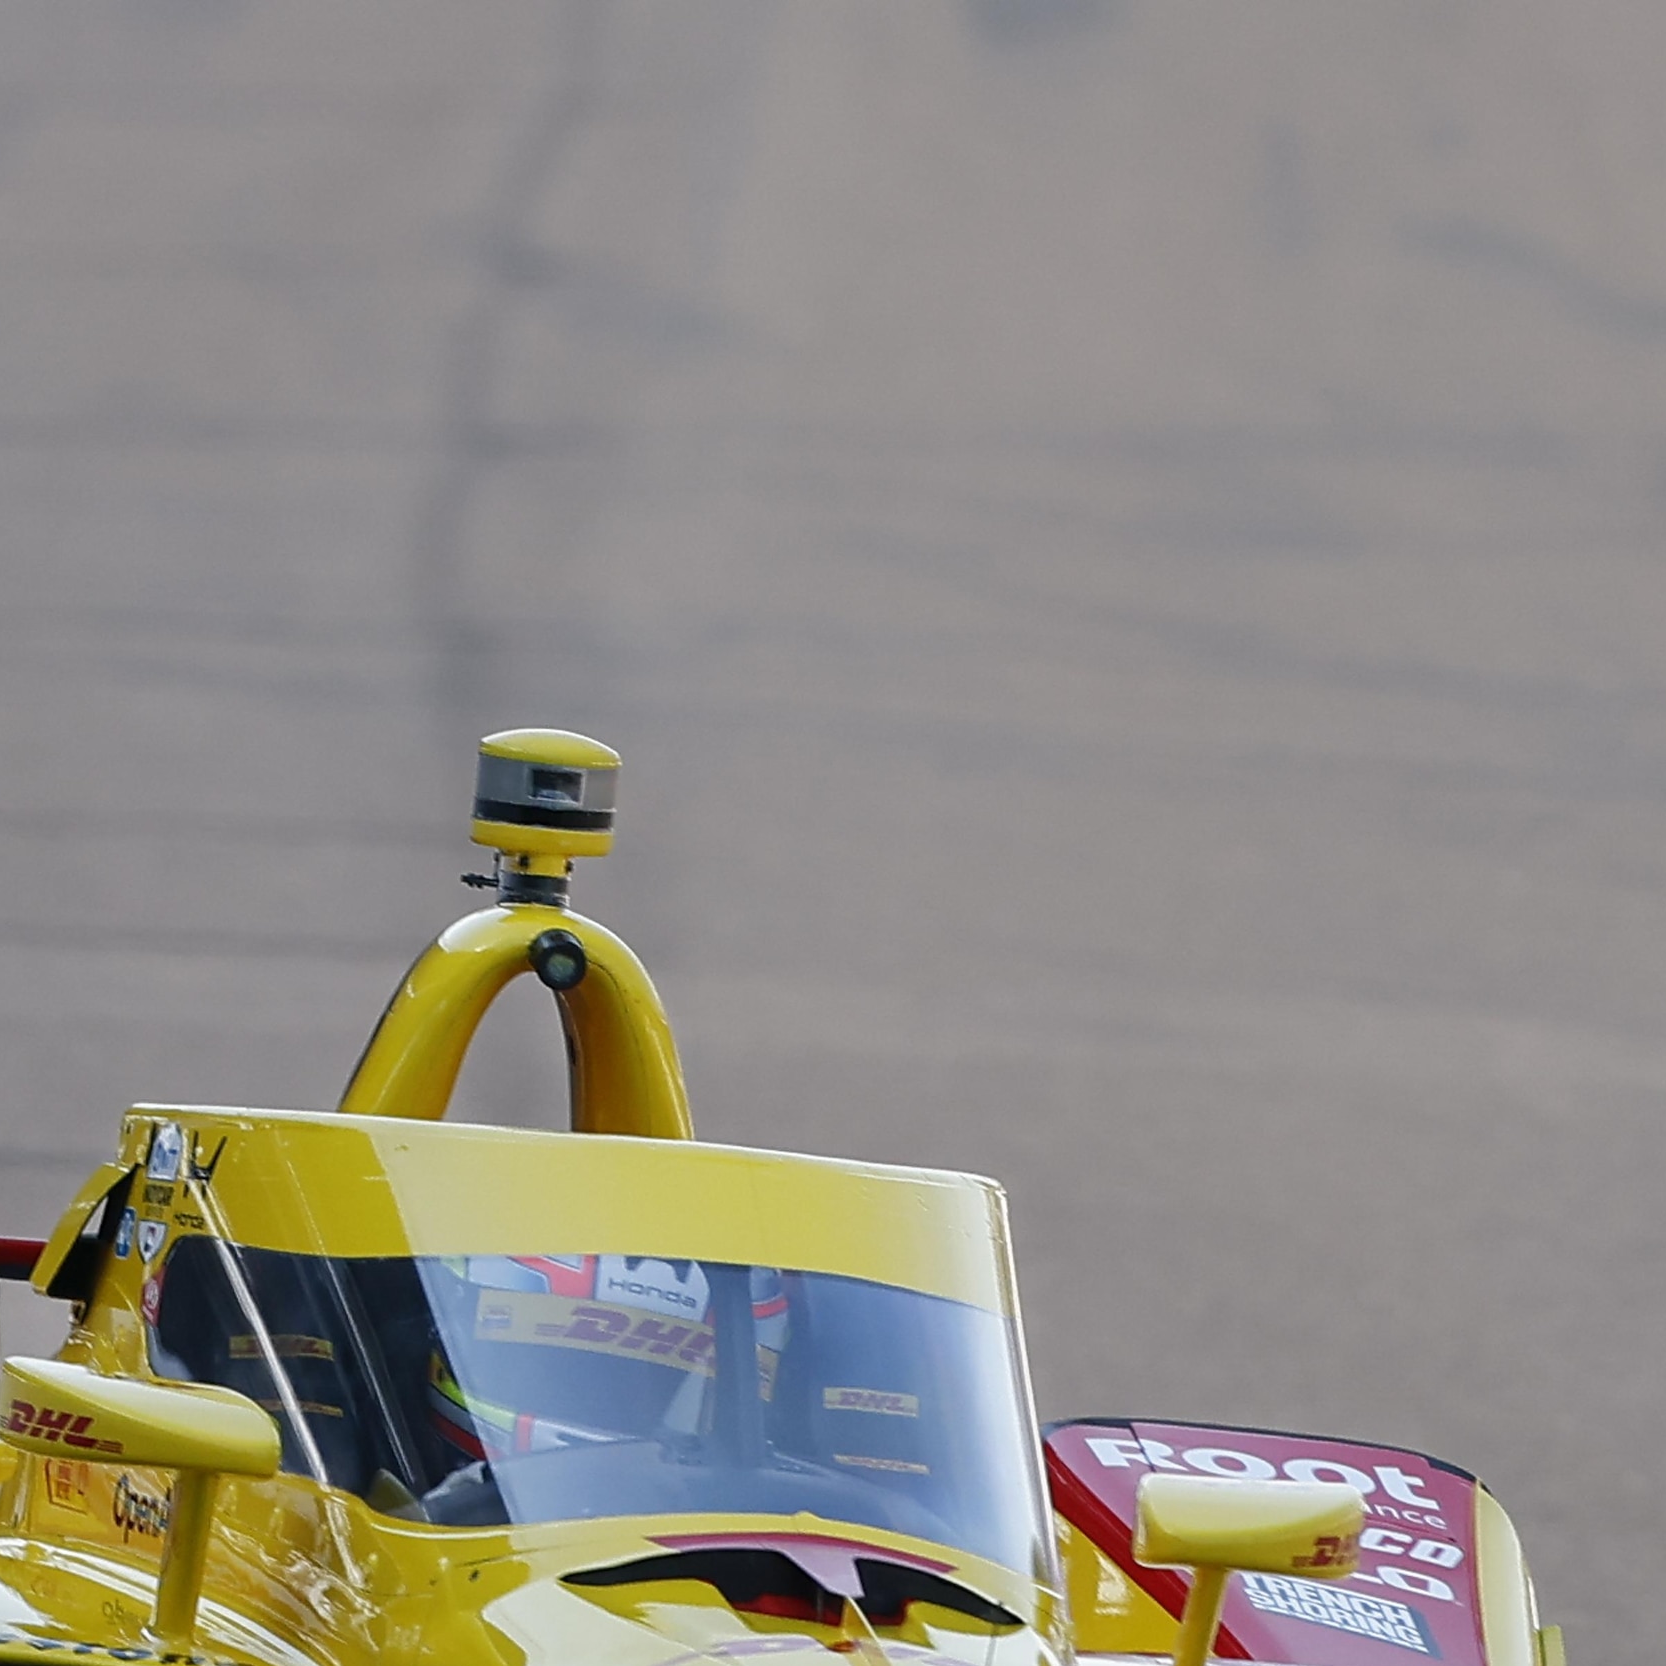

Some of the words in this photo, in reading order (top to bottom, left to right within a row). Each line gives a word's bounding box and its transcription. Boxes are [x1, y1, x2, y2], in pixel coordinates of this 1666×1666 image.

[7, 1399, 99, 1448] DHL
[1239, 1572, 1418, 1630] TRENCH
[1243, 1587, 1425, 1646] SHORING
